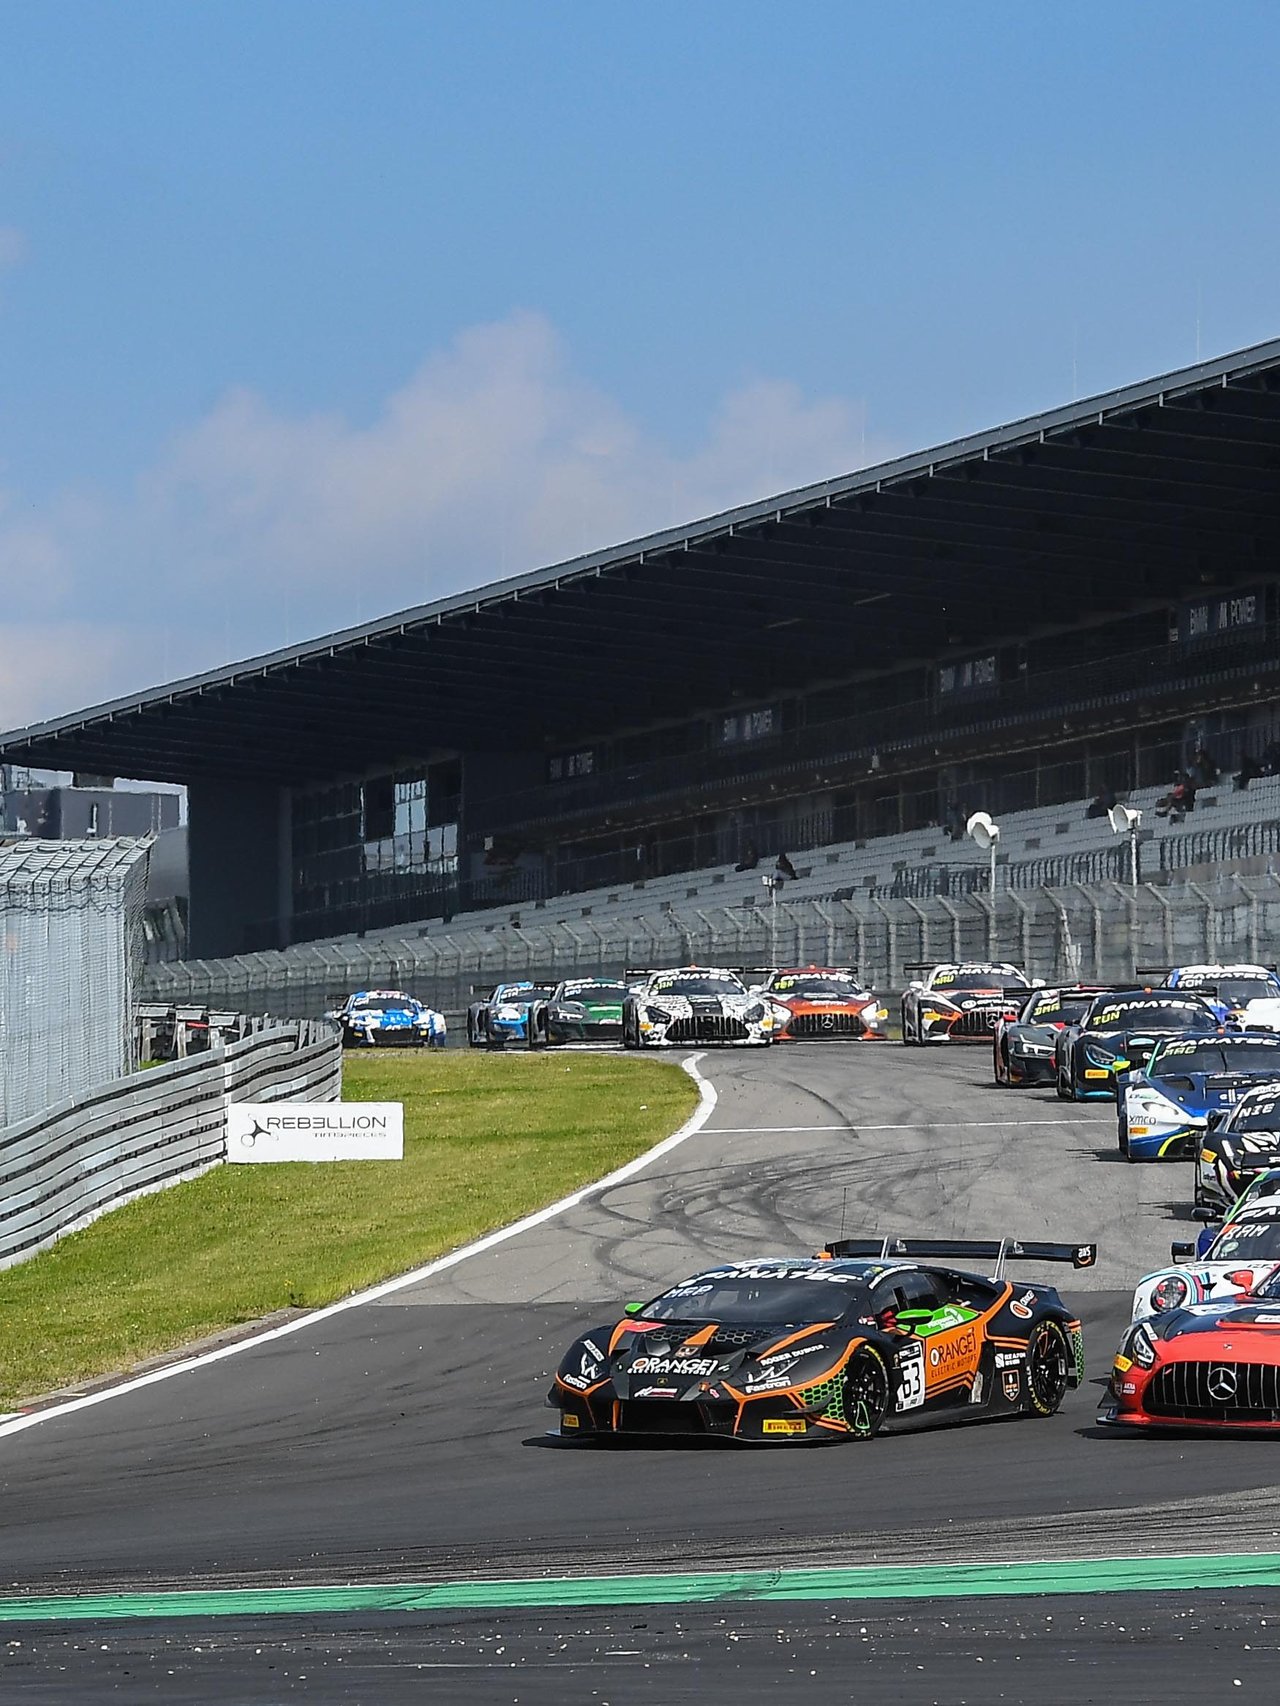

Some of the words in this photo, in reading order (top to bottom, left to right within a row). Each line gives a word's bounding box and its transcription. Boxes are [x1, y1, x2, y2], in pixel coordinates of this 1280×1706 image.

[1102, 1000, 1203, 1014] FANATEC
[1093, 1011, 1120, 1026] TUN
[1165, 1037, 1280, 1048] FANATEC
[1239, 1103, 1275, 1117] NIE
[1222, 1225, 1270, 1240] BAM
[695, 1268, 859, 1284] FANATEC
[930, 1327, 977, 1367] ORANGE1
[632, 1357, 718, 1376] ORANGE1
[761, 1352, 792, 1366] ROGER
[745, 1379, 791, 1394] Fastron
